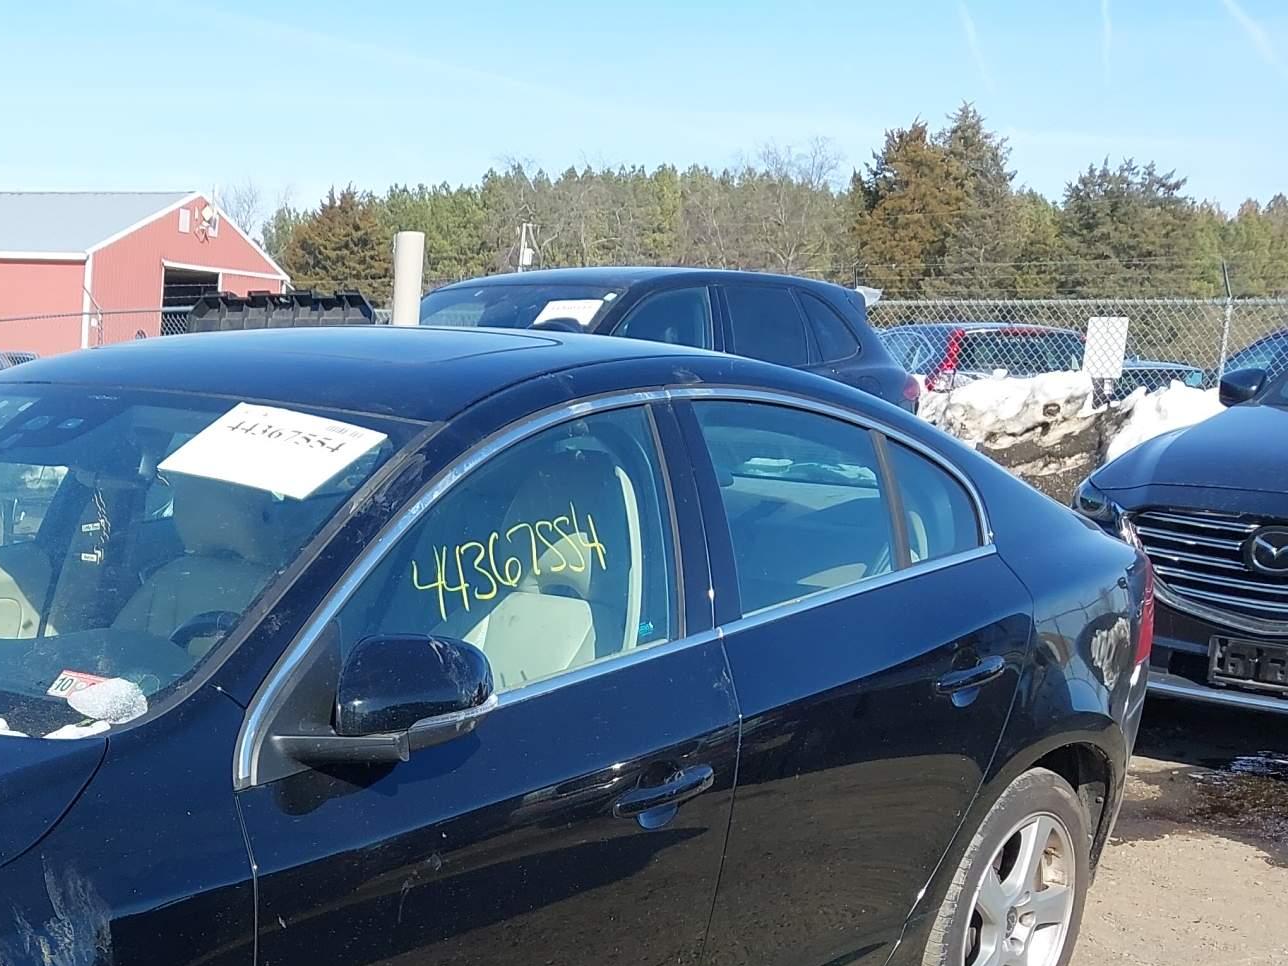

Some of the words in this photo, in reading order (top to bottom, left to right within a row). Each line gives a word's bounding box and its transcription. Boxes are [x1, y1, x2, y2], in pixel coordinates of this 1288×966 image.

[226, 420, 347, 453] 44367554
[412, 500, 607, 622] 44367554
[54, 678, 74, 692] 10
